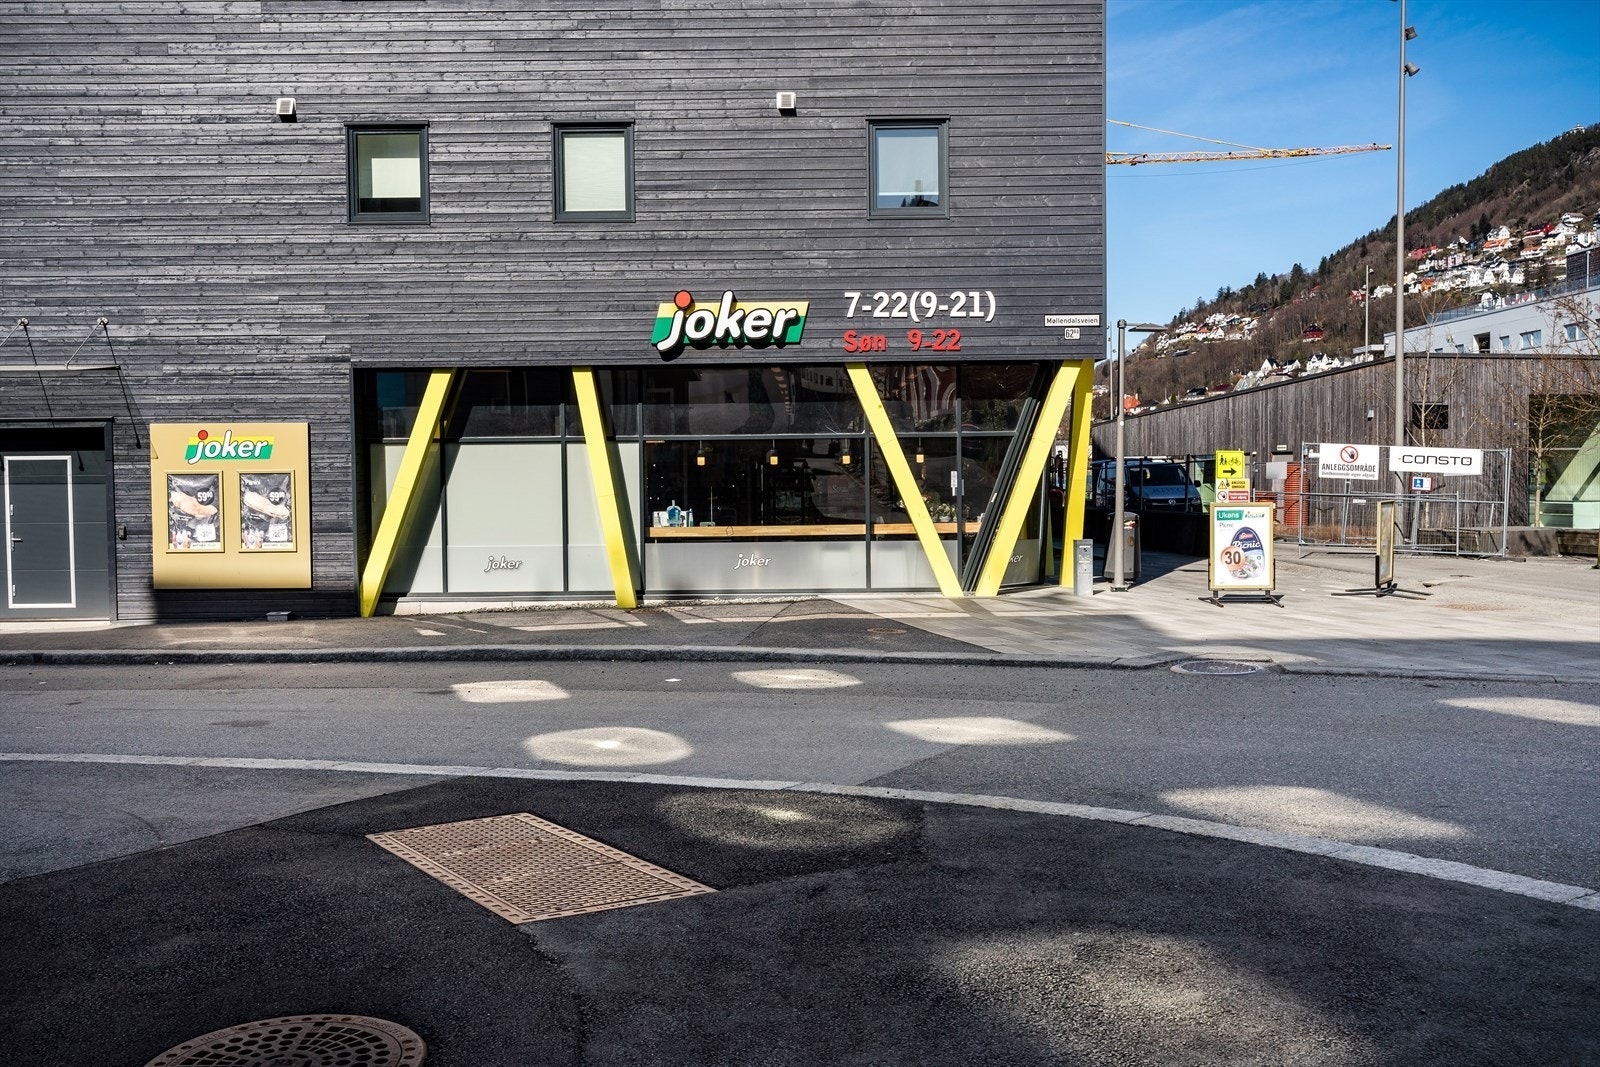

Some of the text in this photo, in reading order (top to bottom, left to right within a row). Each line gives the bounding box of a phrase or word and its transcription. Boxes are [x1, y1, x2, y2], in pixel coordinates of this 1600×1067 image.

[844, 290, 996, 322] 7-22(9-21)
[656, 290, 799, 352] joker
[1046, 317, 1099, 325] Møllendalsveien
[843, 329, 962, 353] Søn 9-22
[188, 429, 269, 465] joker
[1321, 463, 1377, 473] ANLEGGSOMRÅDE
[1218, 511, 1240, 519] Ukens
[484, 555, 522, 572] joker
[734, 553, 771, 570] joker
[1009, 551, 1024, 563] ker
[1224, 551, 1241, 565] 30
